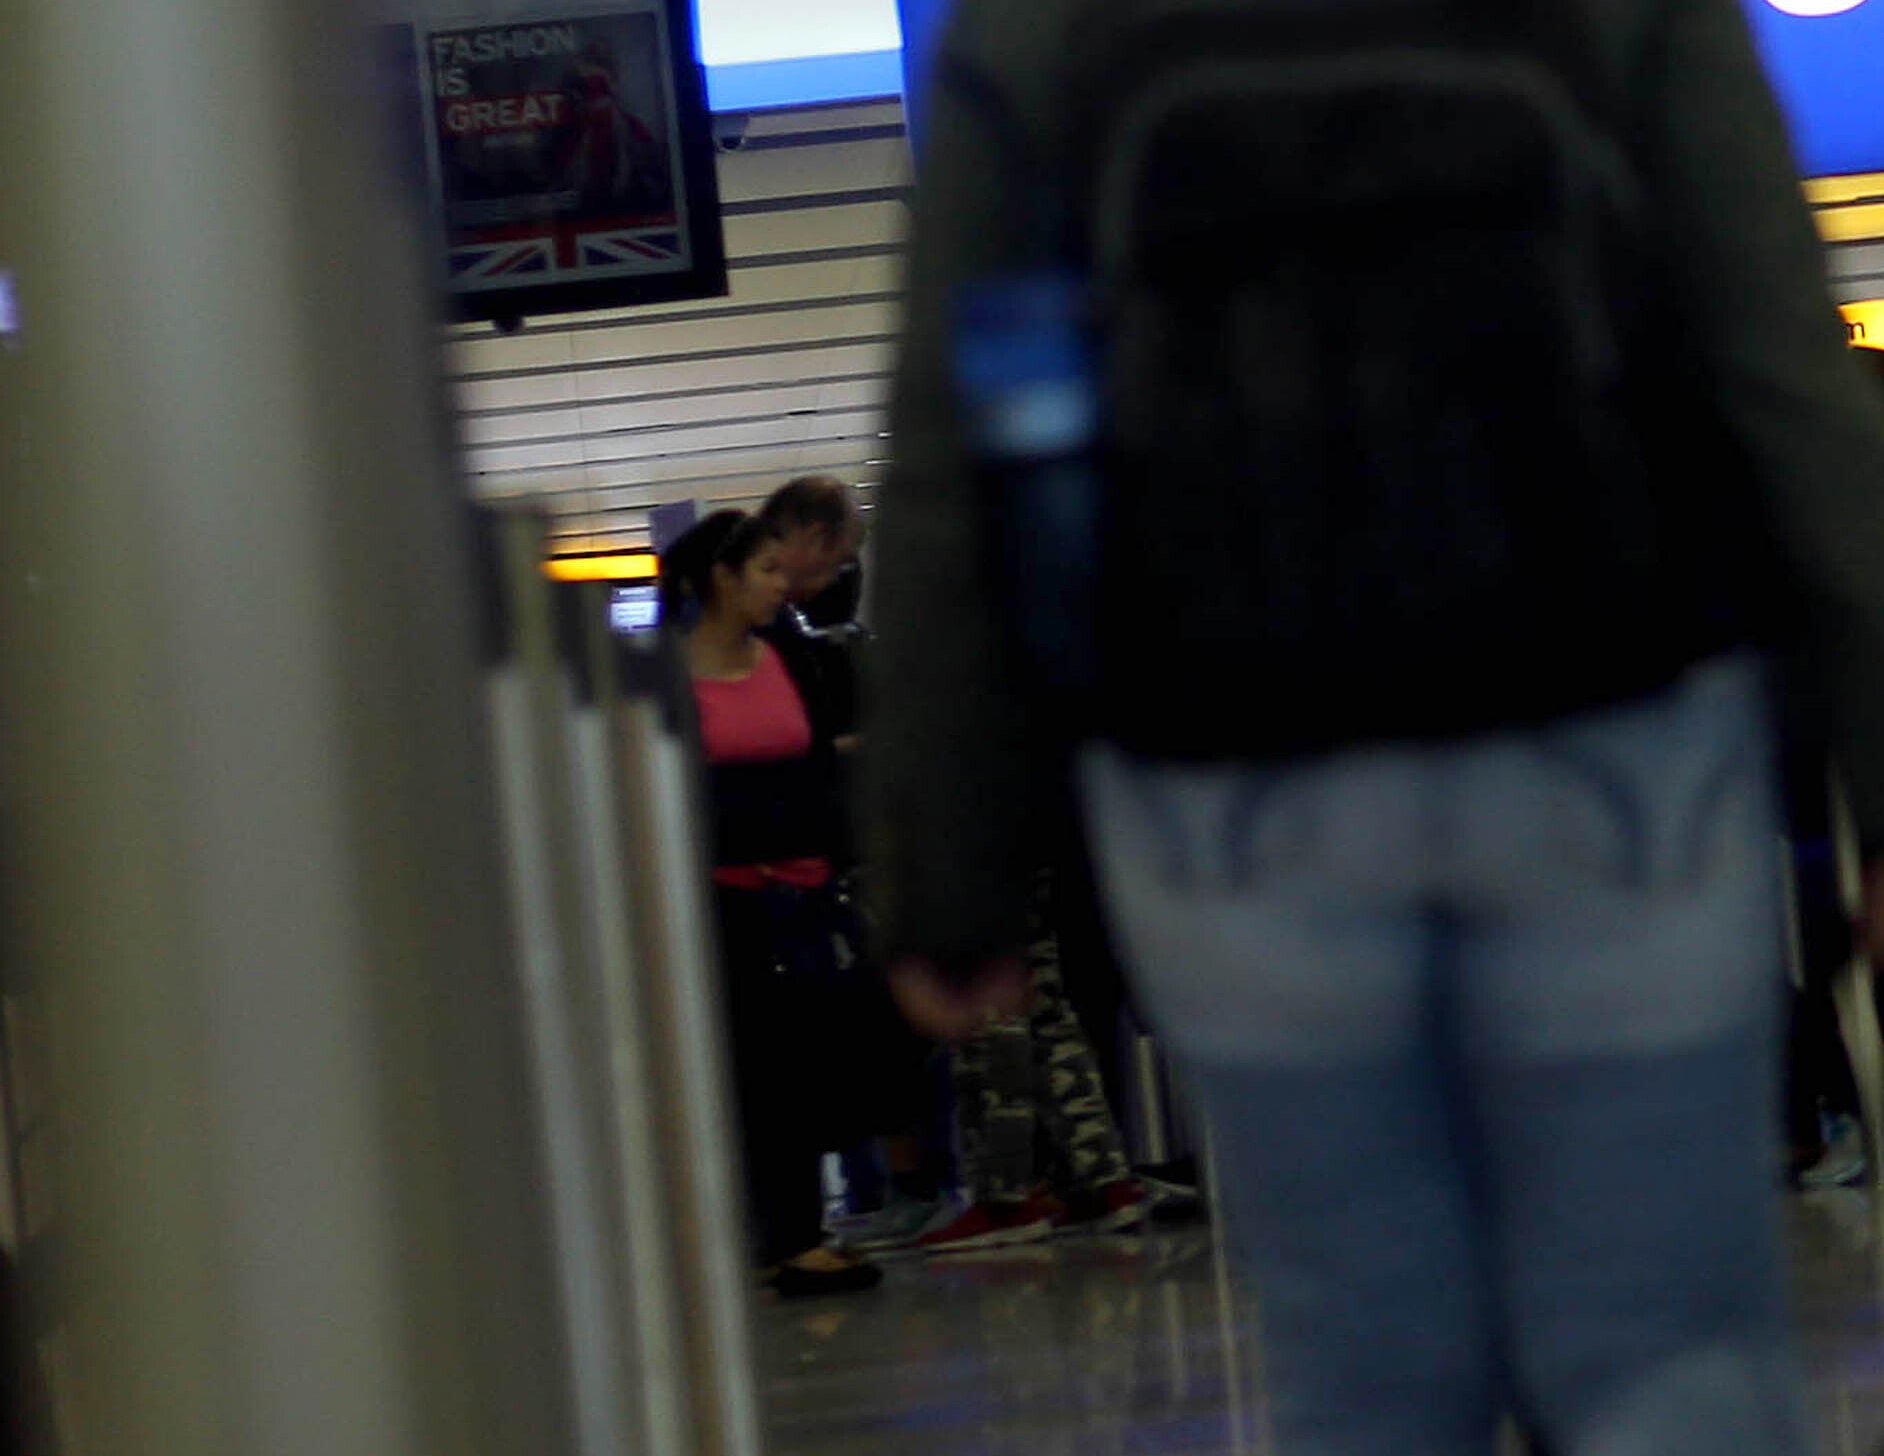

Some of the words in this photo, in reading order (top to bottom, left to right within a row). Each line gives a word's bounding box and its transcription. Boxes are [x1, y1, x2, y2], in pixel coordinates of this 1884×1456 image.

[435, 24, 574, 64] FASHION
[437, 68, 470, 96] IS
[446, 94, 563, 131] GREAT
